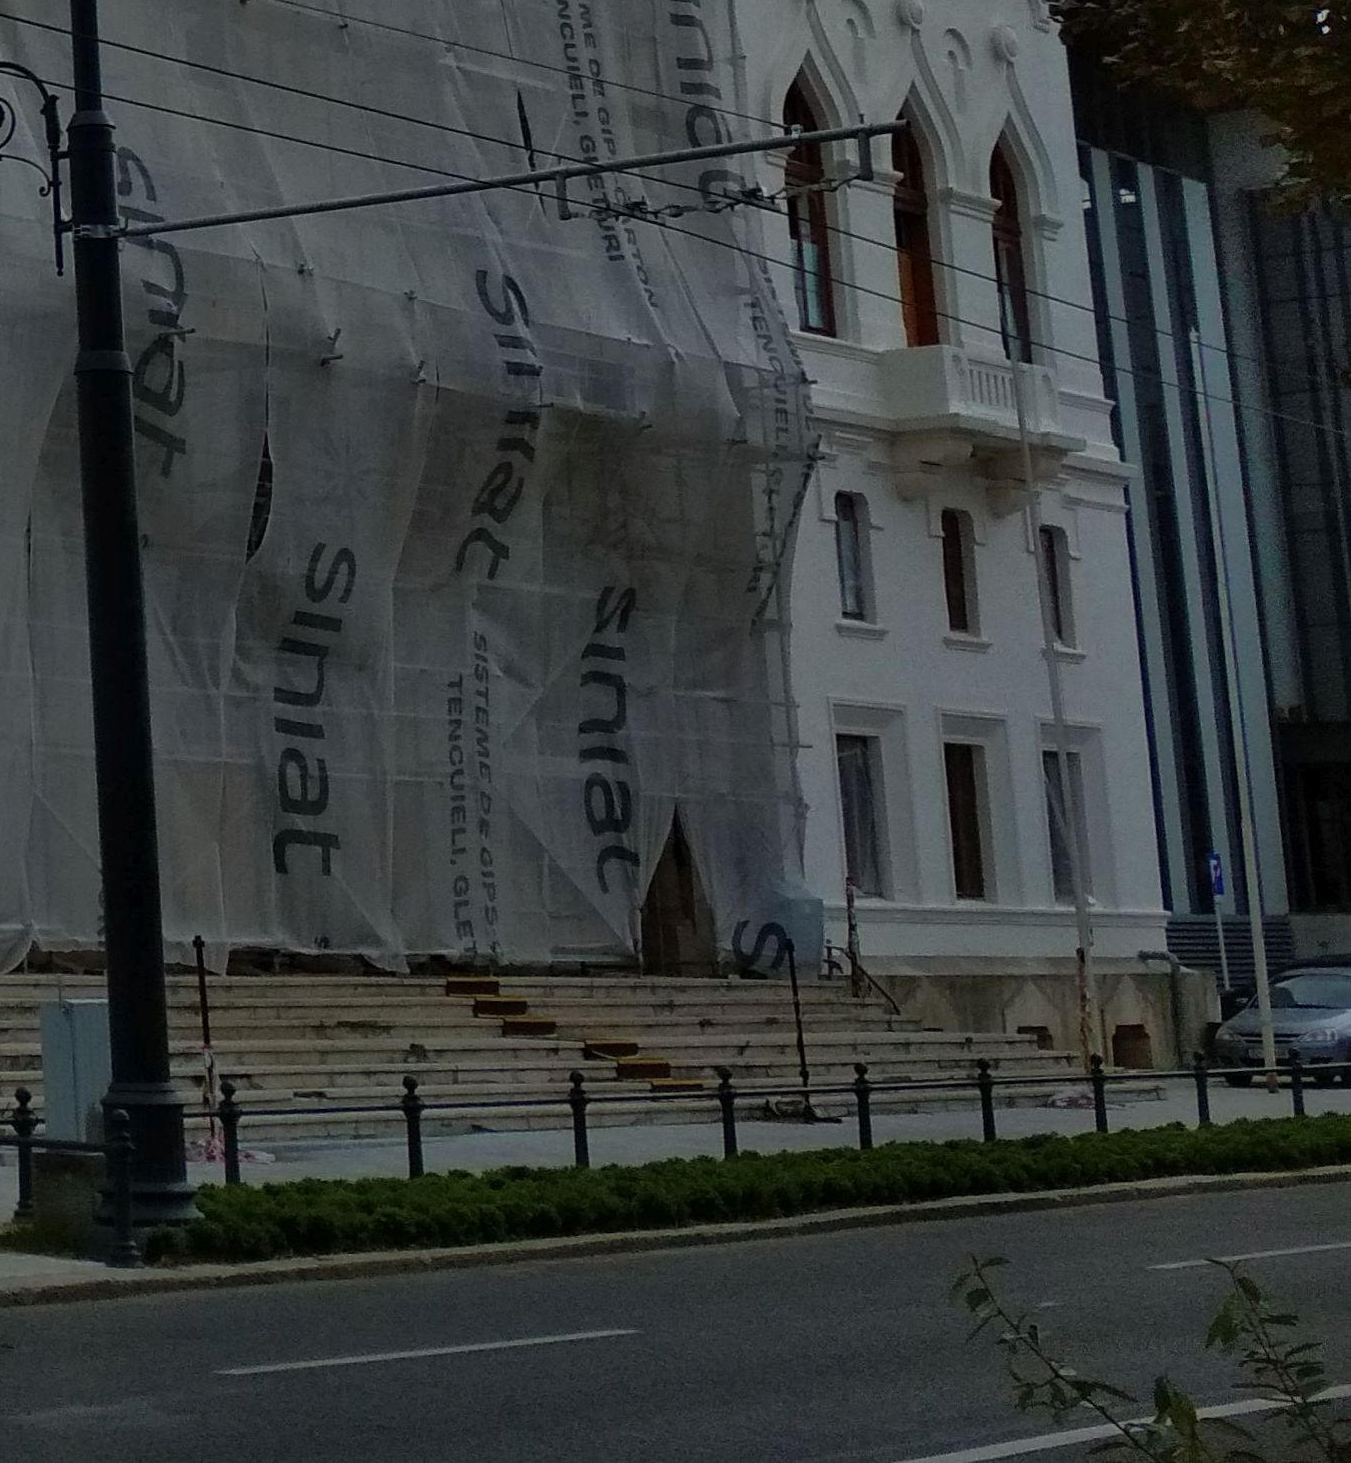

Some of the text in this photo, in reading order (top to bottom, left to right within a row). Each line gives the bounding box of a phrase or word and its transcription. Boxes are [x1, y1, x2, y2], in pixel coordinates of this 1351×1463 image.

[473, 631, 493, 783] SISTEME
[446, 673, 478, 957] TENCUIELI, GLET
[478, 791, 493, 838] DE
